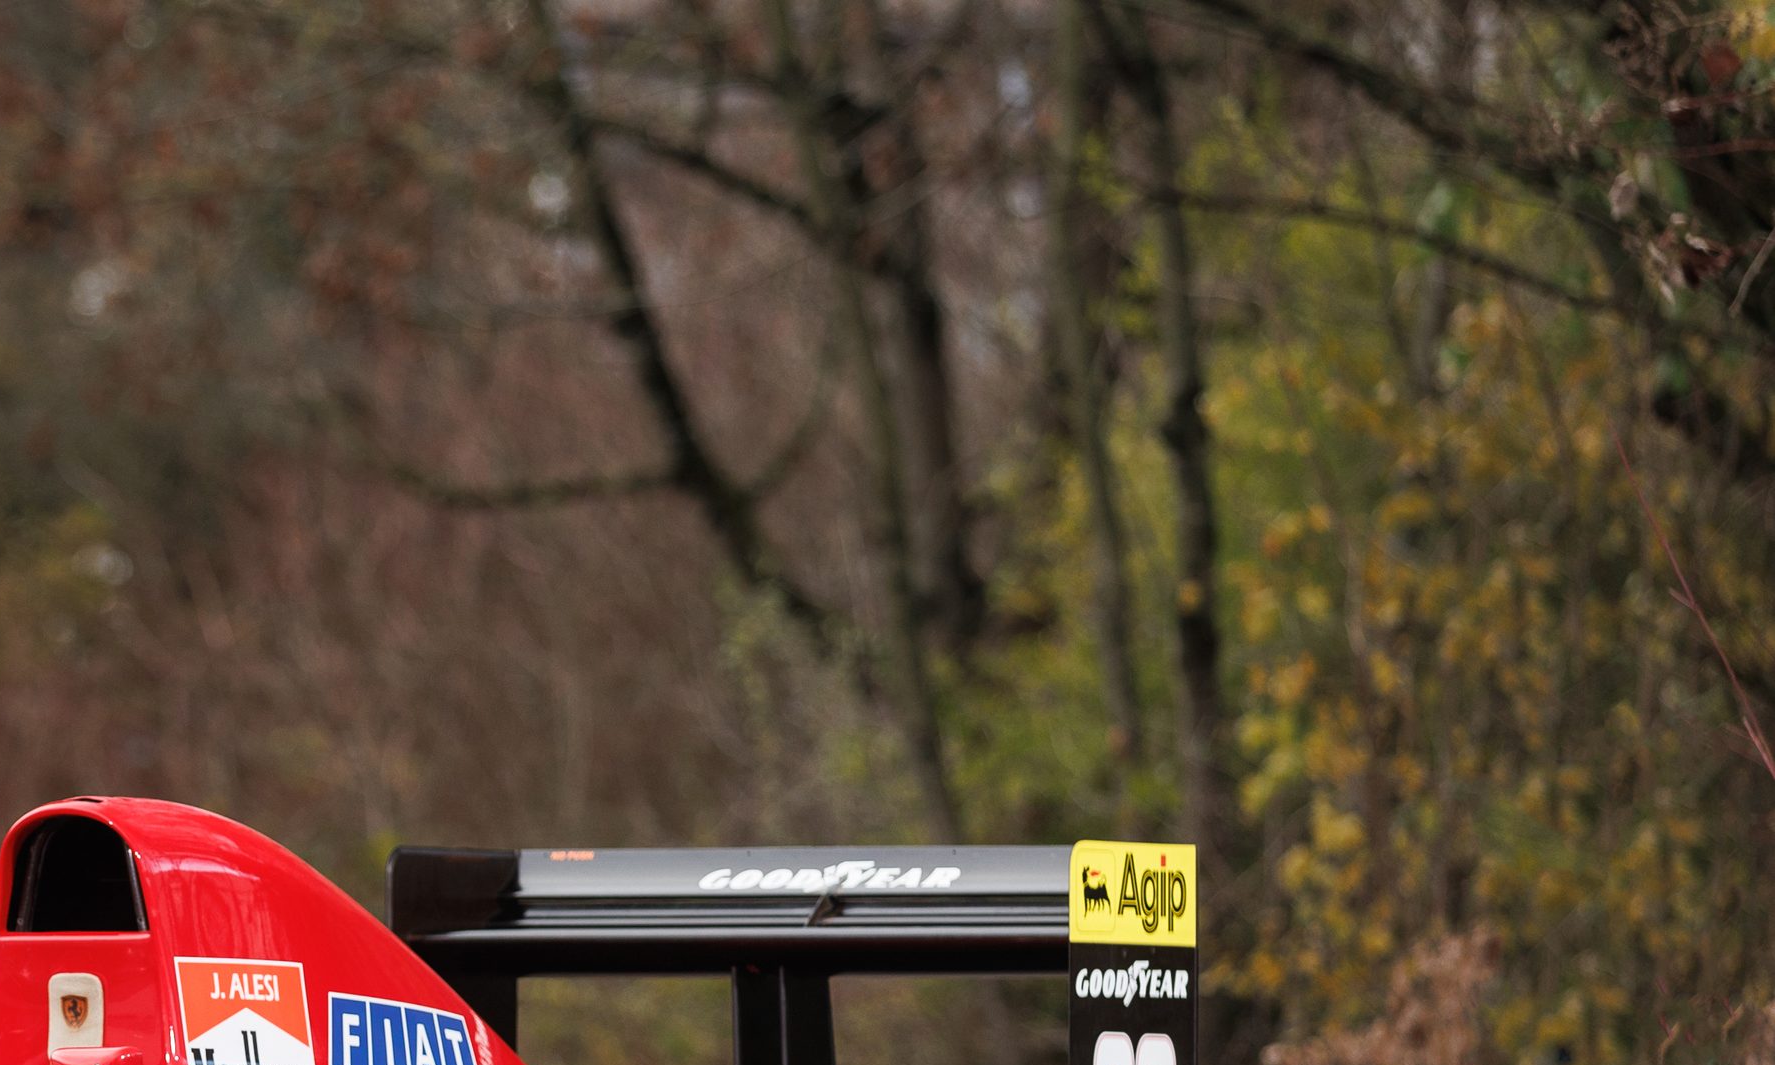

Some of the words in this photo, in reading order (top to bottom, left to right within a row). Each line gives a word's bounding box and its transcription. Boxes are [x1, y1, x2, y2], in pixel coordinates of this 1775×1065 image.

[698, 860, 961, 893] GOODYEAR
[1118, 853, 1187, 934] Agip
[210, 972, 226, 1000] J.
[229, 973, 280, 1002] ALESI
[1075, 960, 1189, 1007] GOODYEAR
